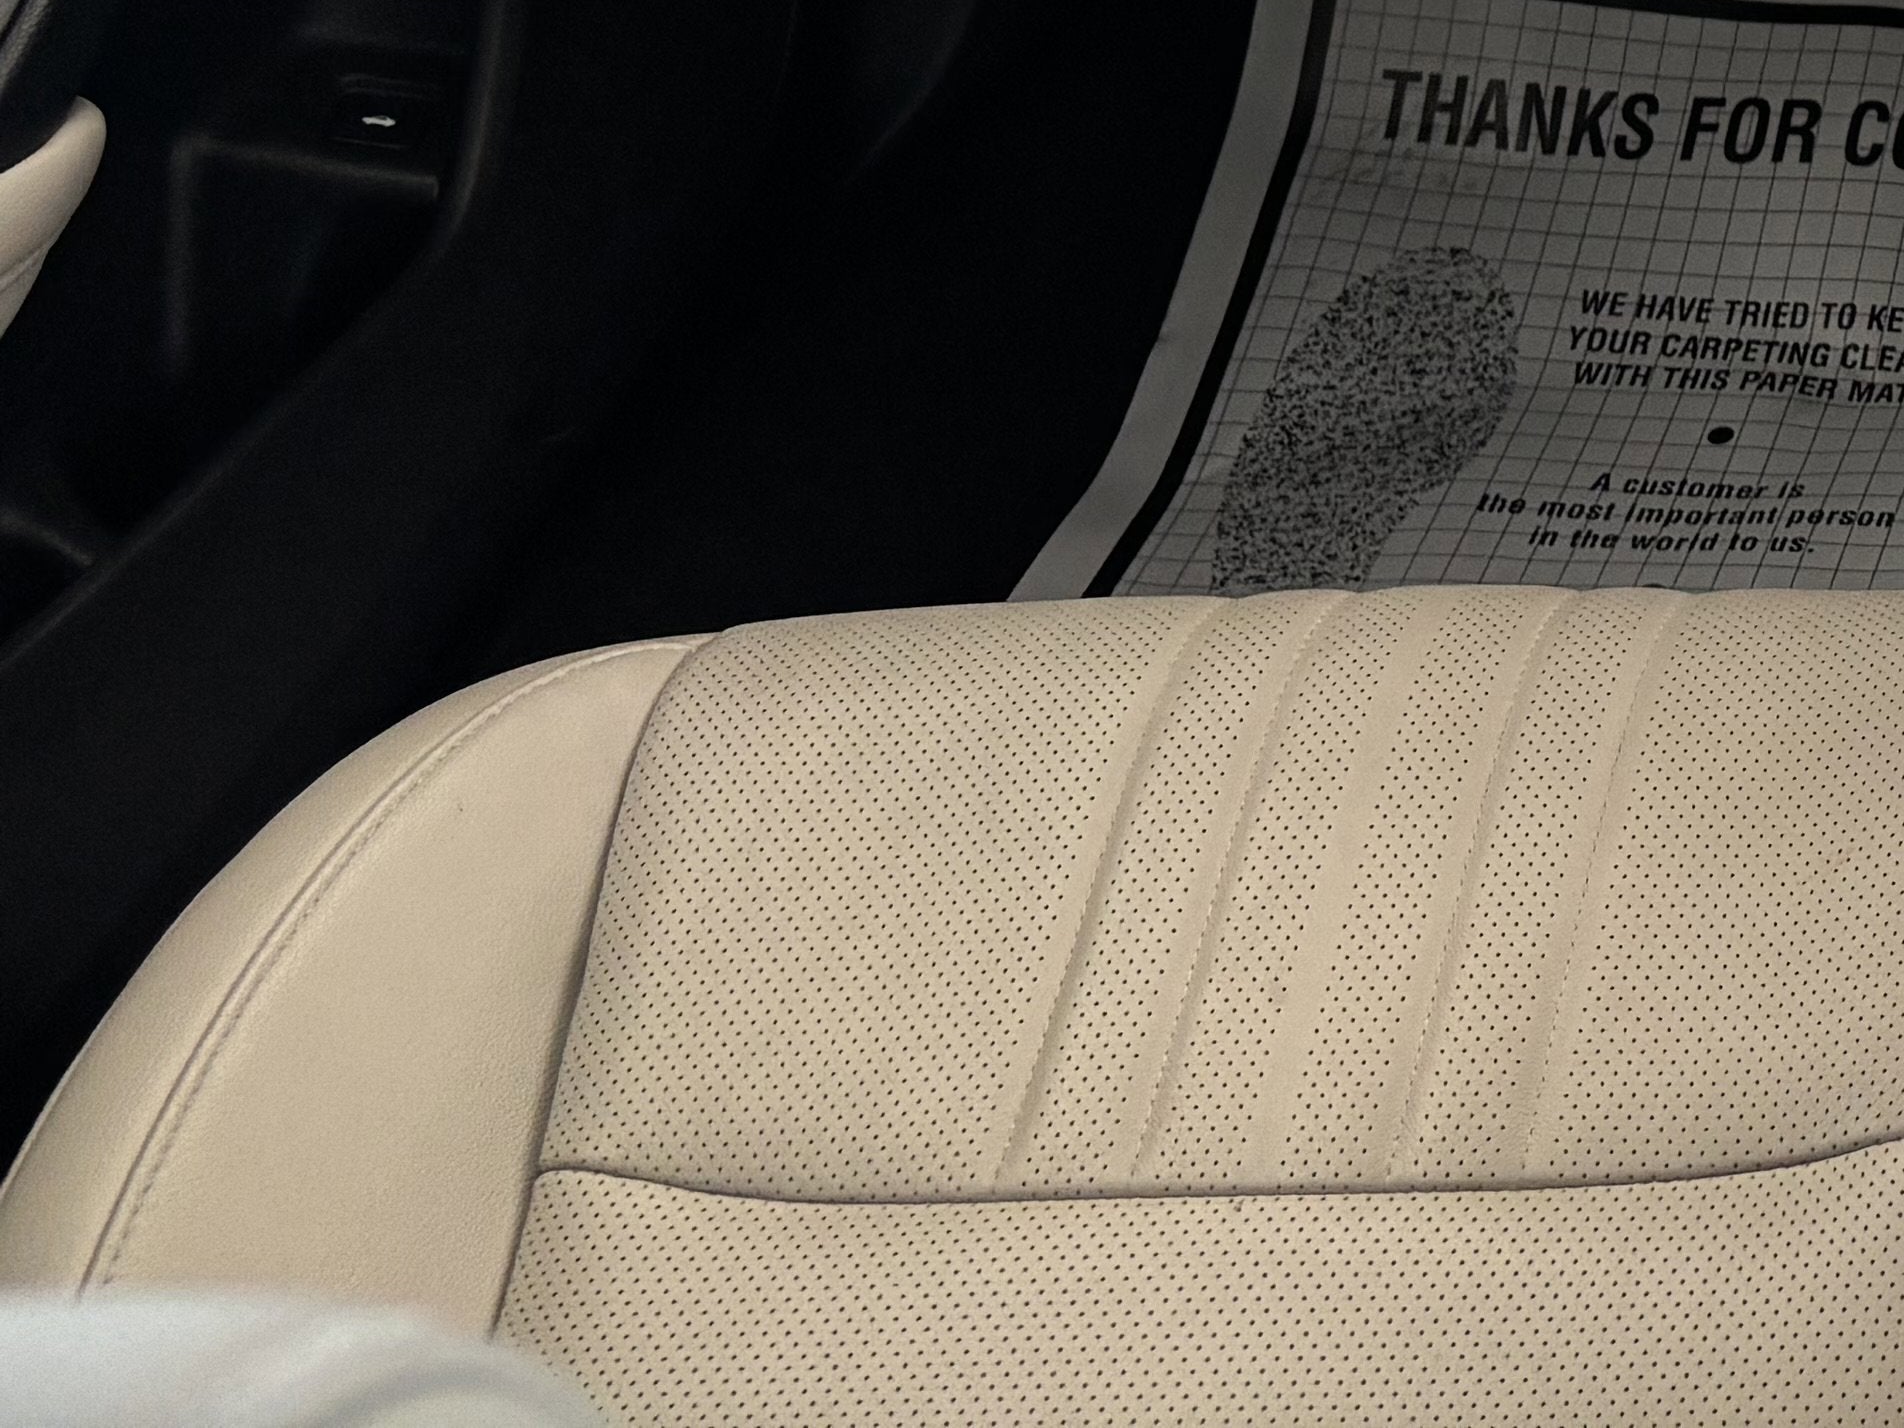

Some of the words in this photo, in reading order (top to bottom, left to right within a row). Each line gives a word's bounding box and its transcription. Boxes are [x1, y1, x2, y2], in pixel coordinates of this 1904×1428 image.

[1382, 69, 1661, 161] THANKS
[1680, 96, 1824, 165] FOR
[1580, 289, 1628, 317] WE
[1634, 294, 1716, 325] HAVE
[1724, 299, 1811, 330] TRIED
[1821, 302, 1856, 331] TO
[1569, 326, 1652, 357] YOUR
[1660, 332, 1830, 369] CARPETING
[1573, 362, 1651, 388] WITH
[1663, 366, 1730, 392] THIS
[1738, 371, 1838, 401] PAPER
[1590, 473, 1612, 493] A
[1622, 477, 1768, 500] customer
[1779, 480, 1806, 499] is
[1476, 493, 1526, 515] the
[1537, 499, 1616, 522] most
[1624, 502, 1778, 530] important
[1784, 507, 1897, 530] person
[1527, 526, 1560, 547] in
[1570, 529, 1622, 549] the
[1629, 530, 1720, 553] world
[1728, 532, 1761, 553] to
[1768, 535, 1817, 554] us.
